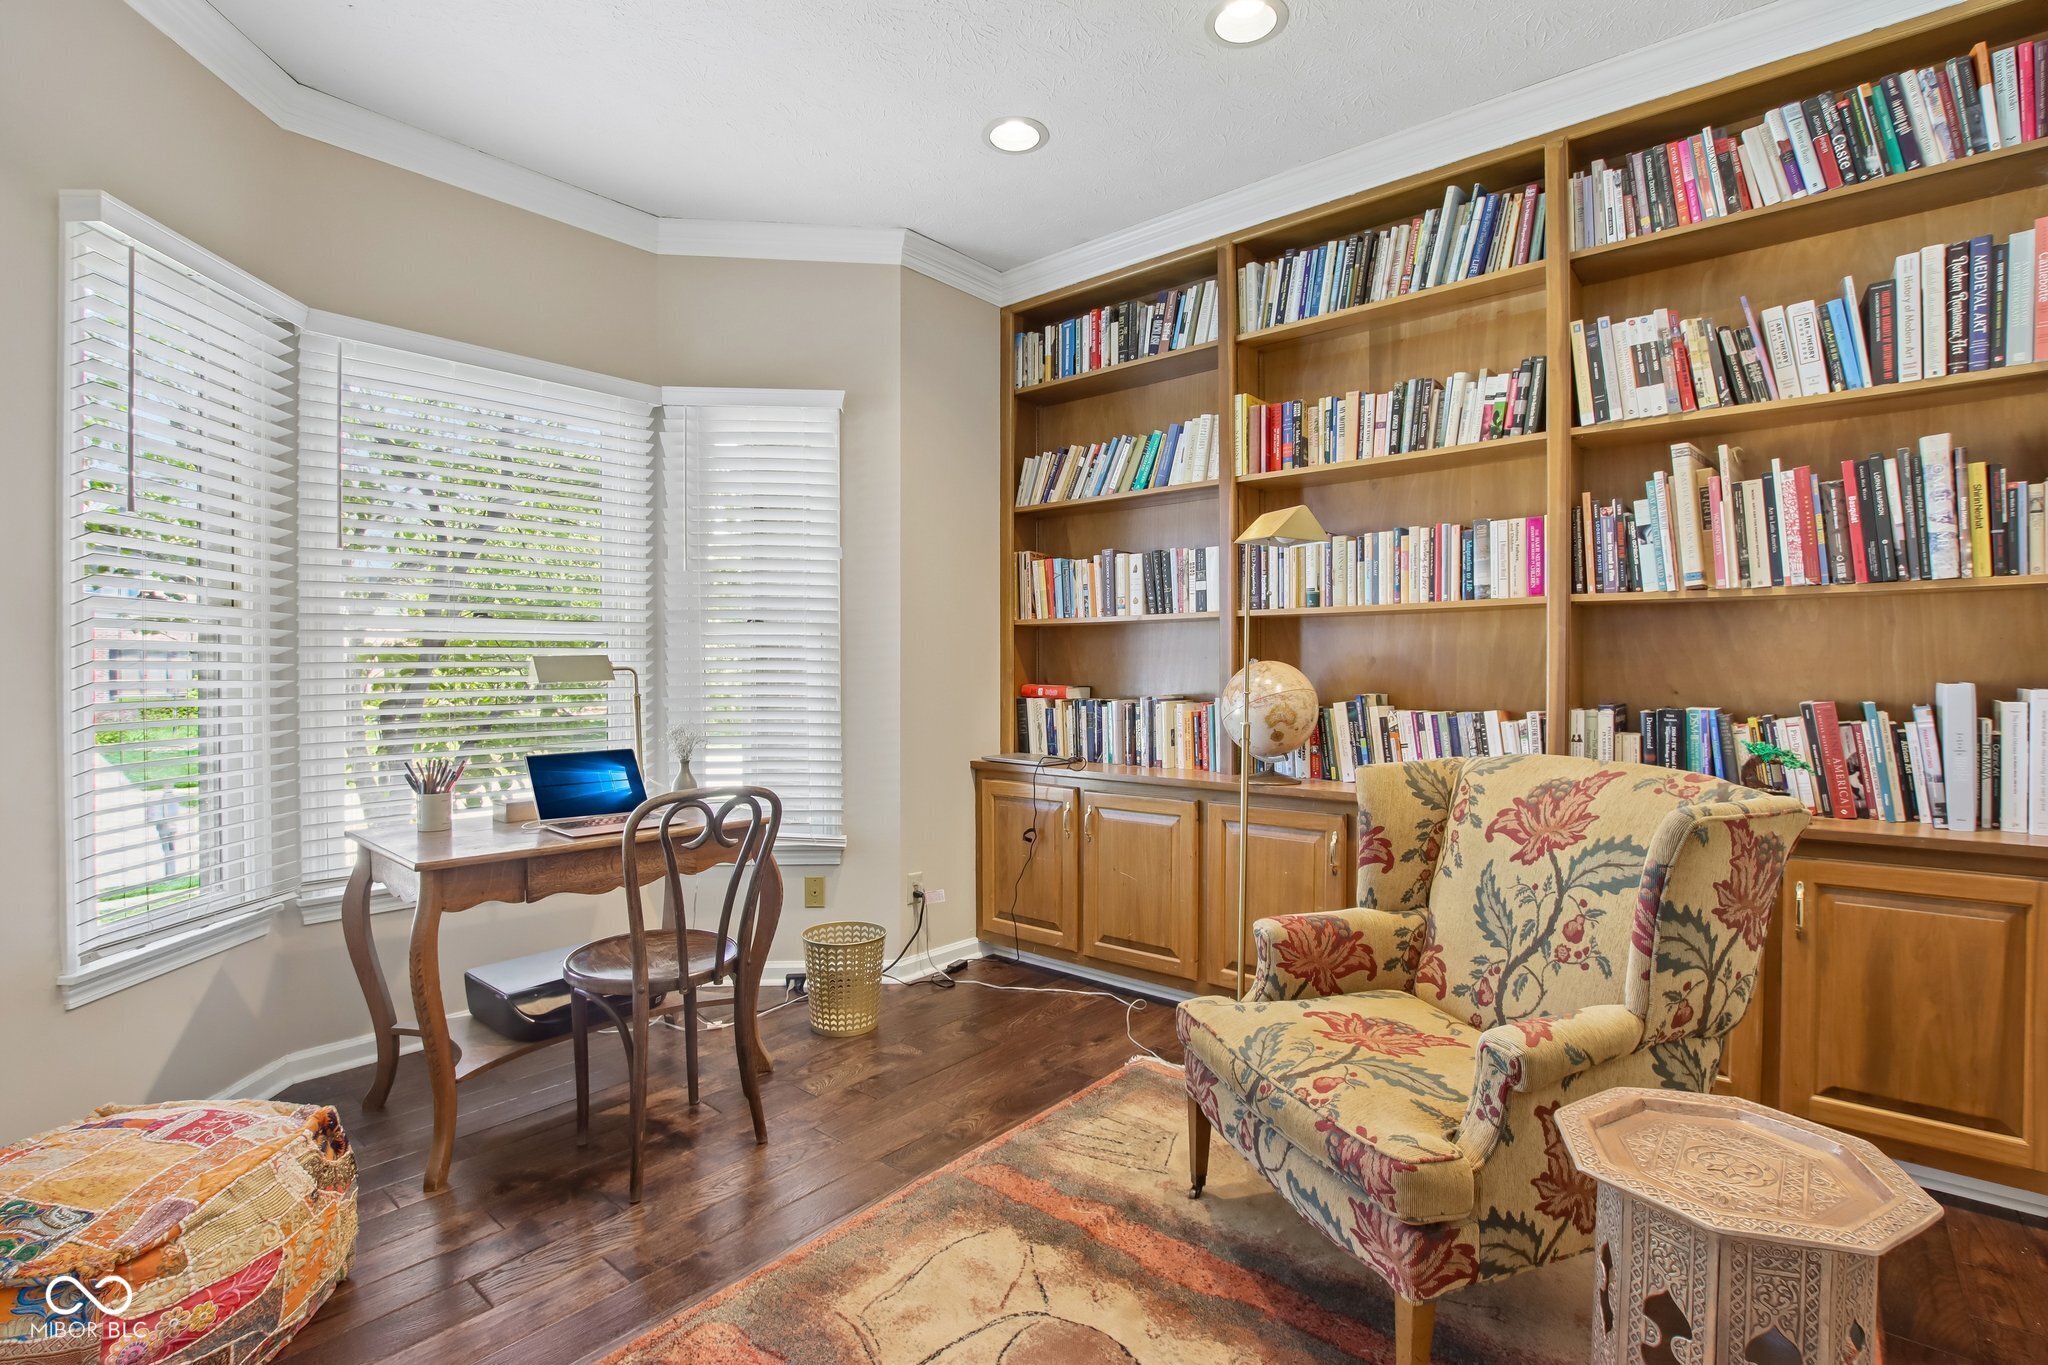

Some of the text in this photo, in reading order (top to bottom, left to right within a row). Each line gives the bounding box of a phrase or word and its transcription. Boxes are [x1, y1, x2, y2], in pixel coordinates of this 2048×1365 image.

[2005, 51, 2014, 69] Middle
[1792, 121, 1802, 130] The
[1812, 114, 1829, 153] ADRIAN PIPER
[1830, 133, 1853, 170] Caste
[1470, 258, 1479, 273] LIFE
[2038, 252, 2048, 302] Caillebotte
[1902, 275, 1912, 302] History
[1973, 255, 1987, 332] MEDIEVAL ART
[1949, 255, 1968, 354] Northern Renaissance Art
[1149, 318, 1162, 345] BACKLASH
[1161, 321, 1171, 341] Stiffed
[1904, 315, 1914, 344] Modern
[1779, 339, 1788, 363] THEORY
[1806, 334, 1815, 358] THEORY
[1905, 347, 1914, 358] Art
[1734, 371, 1743, 390] MODERN
[1680, 471, 1689, 497] NATIVE
[1847, 495, 1858, 523] Basquiat
[1904, 495, 1912, 513] PIPER
[1972, 484, 1983, 529] Shirin Neshat
[1658, 508, 1668, 530] WRIGHT
[1649, 505, 1661, 548] ARCHITECTURE
[1656, 556, 1664, 577] WORLD
[1789, 729, 1800, 752] Pin-Up
[1870, 718, 1879, 747] Representing
[1900, 740, 1910, 763] African
[1982, 743, 1991, 779] The MAYA
[1831, 756, 1849, 804] AMERICA
